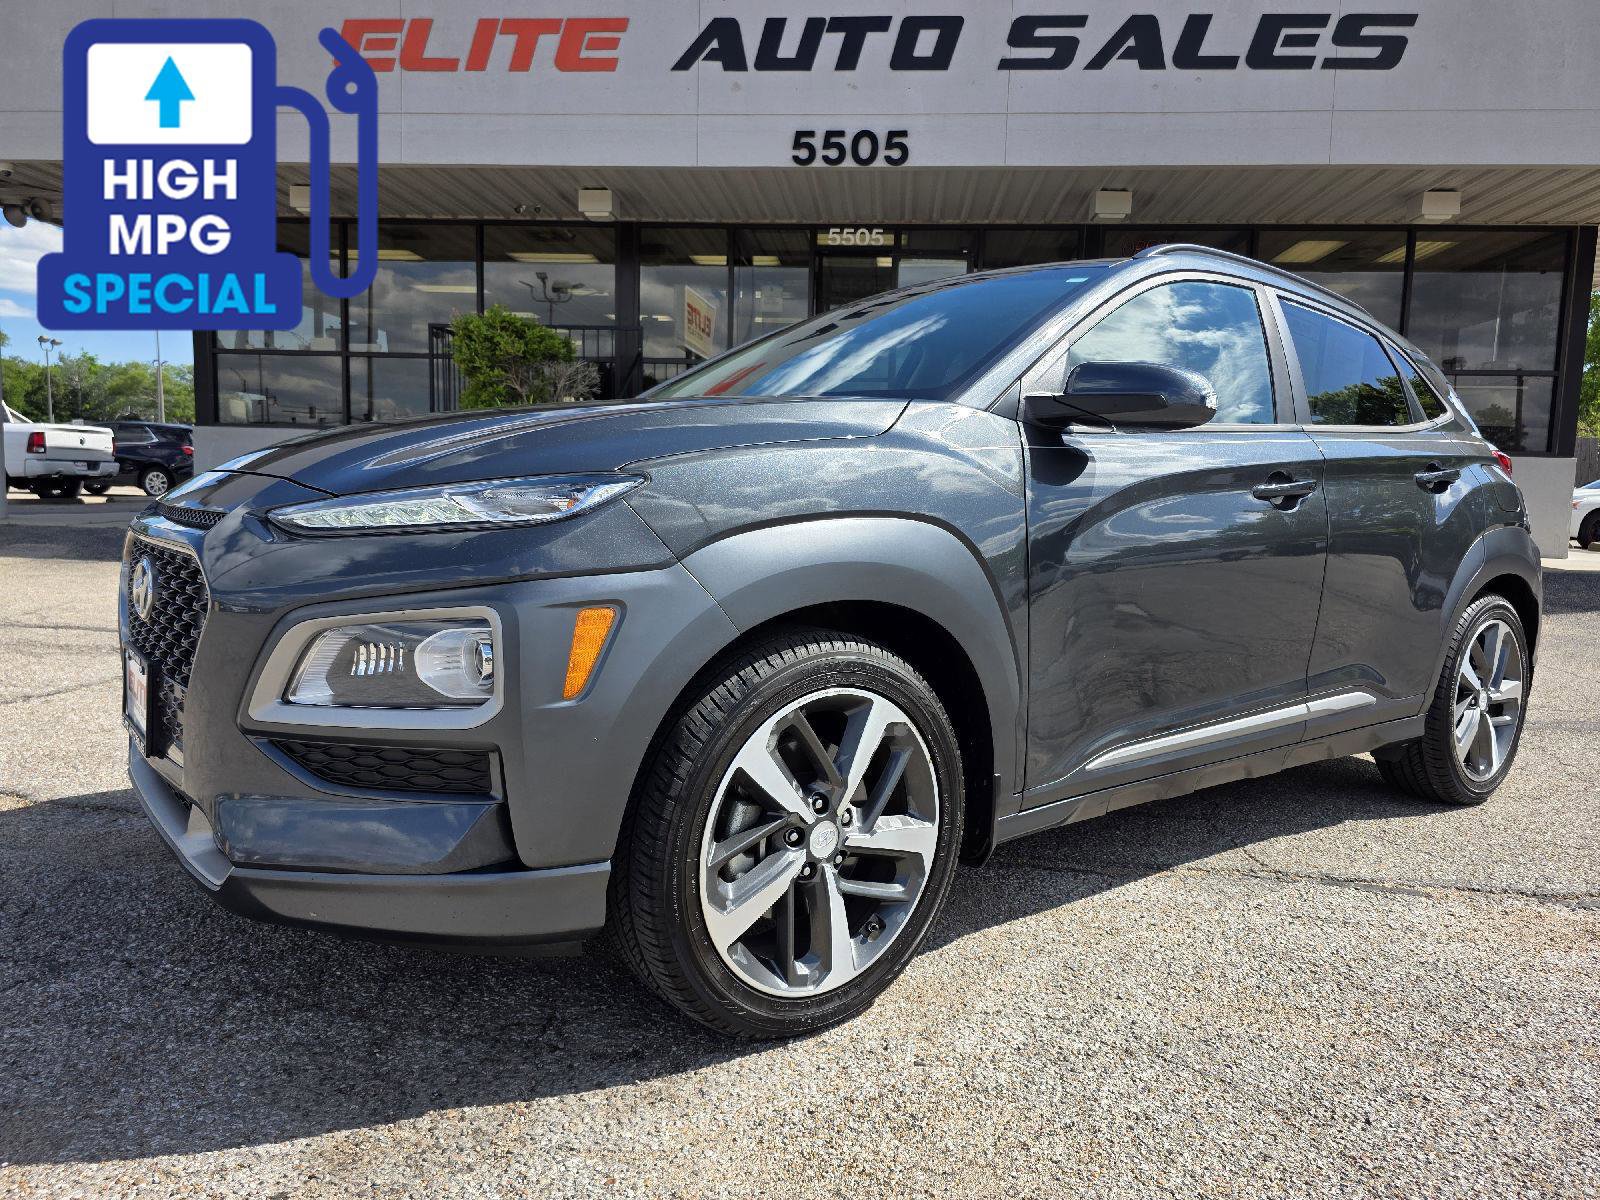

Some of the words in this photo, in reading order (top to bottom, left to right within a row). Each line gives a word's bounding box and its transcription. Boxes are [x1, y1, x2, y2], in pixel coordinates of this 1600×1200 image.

[333, 17, 629, 72] ELITE
[670, 15, 965, 72] AUTO
[997, 13, 1419, 71] SALES
[791, 129, 909, 167] 5505
[827, 228, 884, 246] 5505
